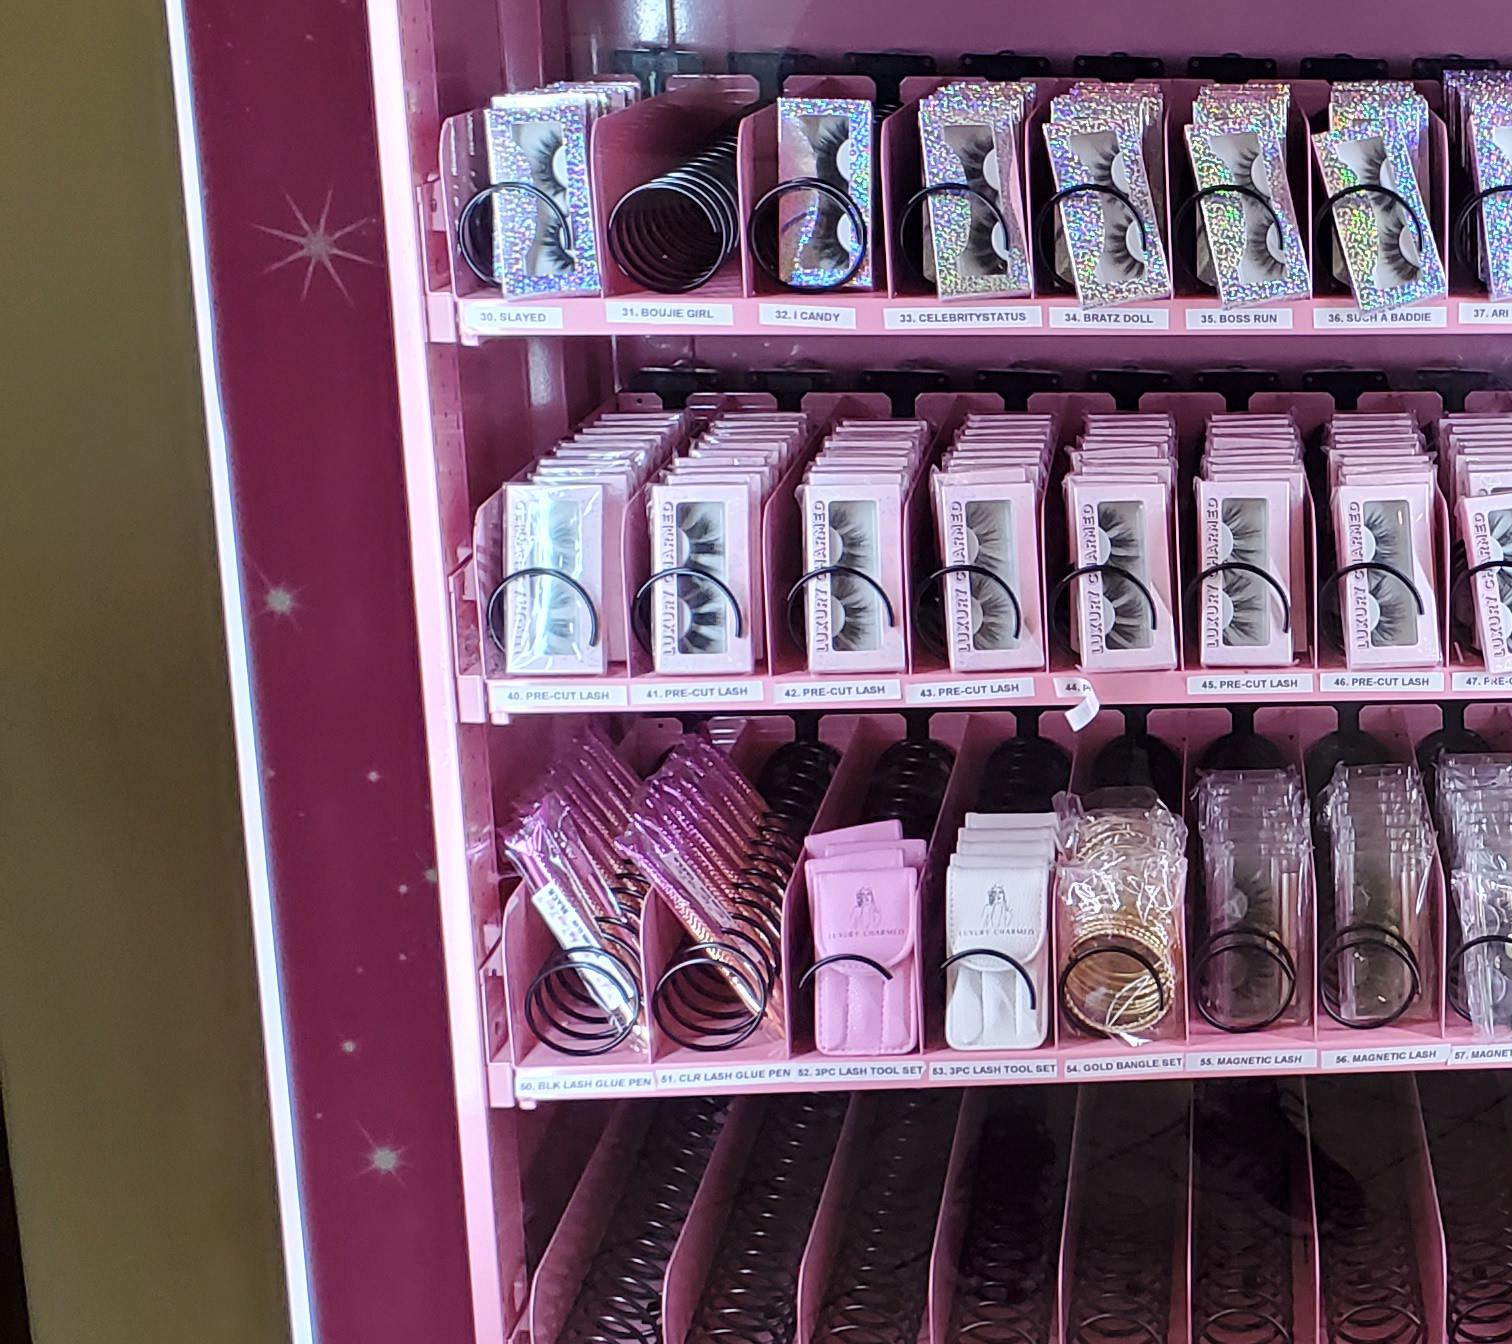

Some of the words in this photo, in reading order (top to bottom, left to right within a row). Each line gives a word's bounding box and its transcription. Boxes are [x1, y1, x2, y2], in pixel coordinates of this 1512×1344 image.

[622, 307, 638, 317] 31.
[641, 307, 683, 318] BOUJIE
[687, 309, 714, 319] GIRL
[775, 310, 791, 320] 32.
[800, 311, 841, 322] CANDY
[898, 313, 917, 323] 33.
[919, 312, 1026, 323] CELEBRITYSTATUS
[1065, 312, 1081, 323] 34.
[1083, 313, 1120, 323] BRATZ
[1123, 313, 1153, 324] DOLL
[1201, 314, 1216, 324] 35.
[1220, 314, 1250, 324] BOSS
[1254, 313, 1277, 323] RUN
[1328, 313, 1344, 323] 36.
[1346, 313, 1377, 323] SUCH
[1391, 312, 1431, 322] BADDIE
[1474, 308, 1488, 318] 37.
[1492, 308, 1508, 318] ARI
[813, 586, 829, 651] LUXURY
[1206, 586, 1219, 648] LUXURY
[1202, 679, 1217, 690] 45.
[1219, 679, 1267, 690] PRE-CUT
[1269, 678, 1298, 689] LASH
[1334, 677, 1349, 688] 46.
[1351, 676, 1400, 687] PRE-CUT
[1402, 676, 1430, 687] LASH
[784, 687, 800, 698] 42.
[802, 686, 853, 697] PRE-CUT
[855, 685, 886, 696] LASH
[1066, 1064, 1081, 1073] 54.
[1083, 1062, 1113, 1072] GOLD
[1117, 1060, 1159, 1070] BANGLE
[1162, 1058, 1182, 1068] SET
[1216, 1057, 1268, 1066] MAGNETIC
[1270, 1056, 1302, 1065] LASH
